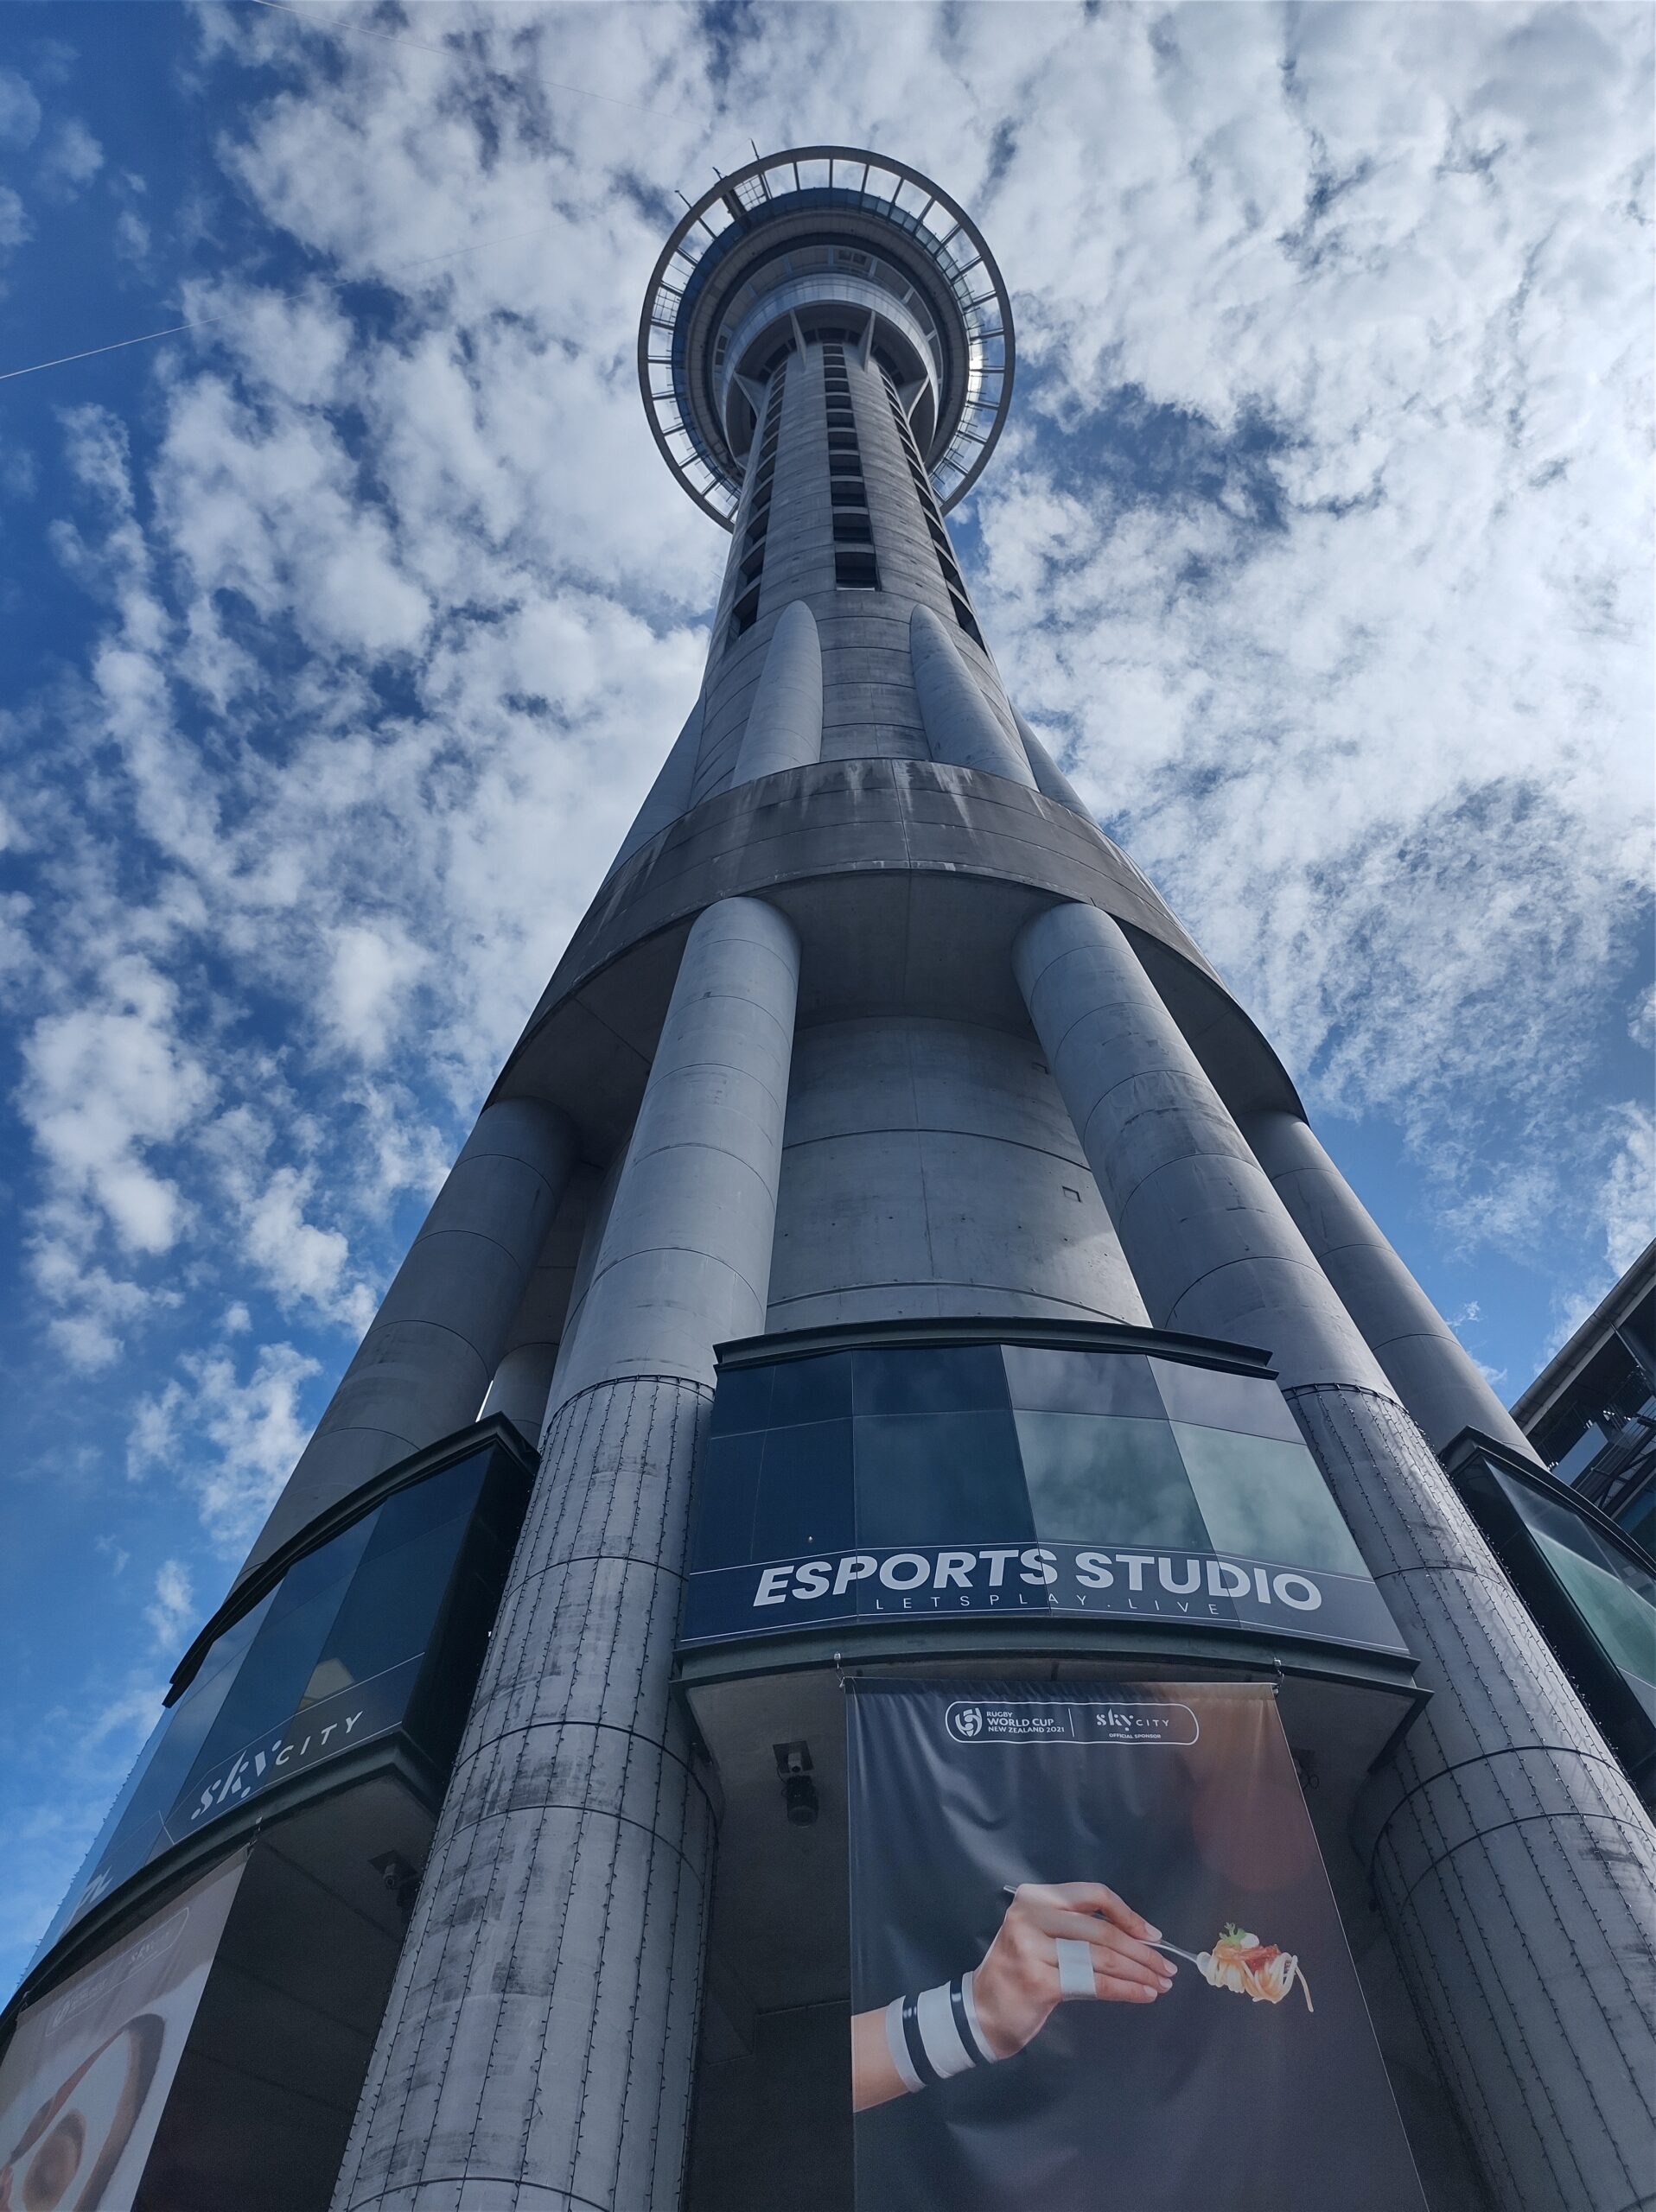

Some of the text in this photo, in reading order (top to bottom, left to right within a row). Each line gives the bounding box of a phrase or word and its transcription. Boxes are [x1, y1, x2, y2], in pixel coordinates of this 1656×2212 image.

[753, 1548, 1322, 1611] ESPORTS STUDIO
[987, 1718, 1054, 1726] WORLD CUP
